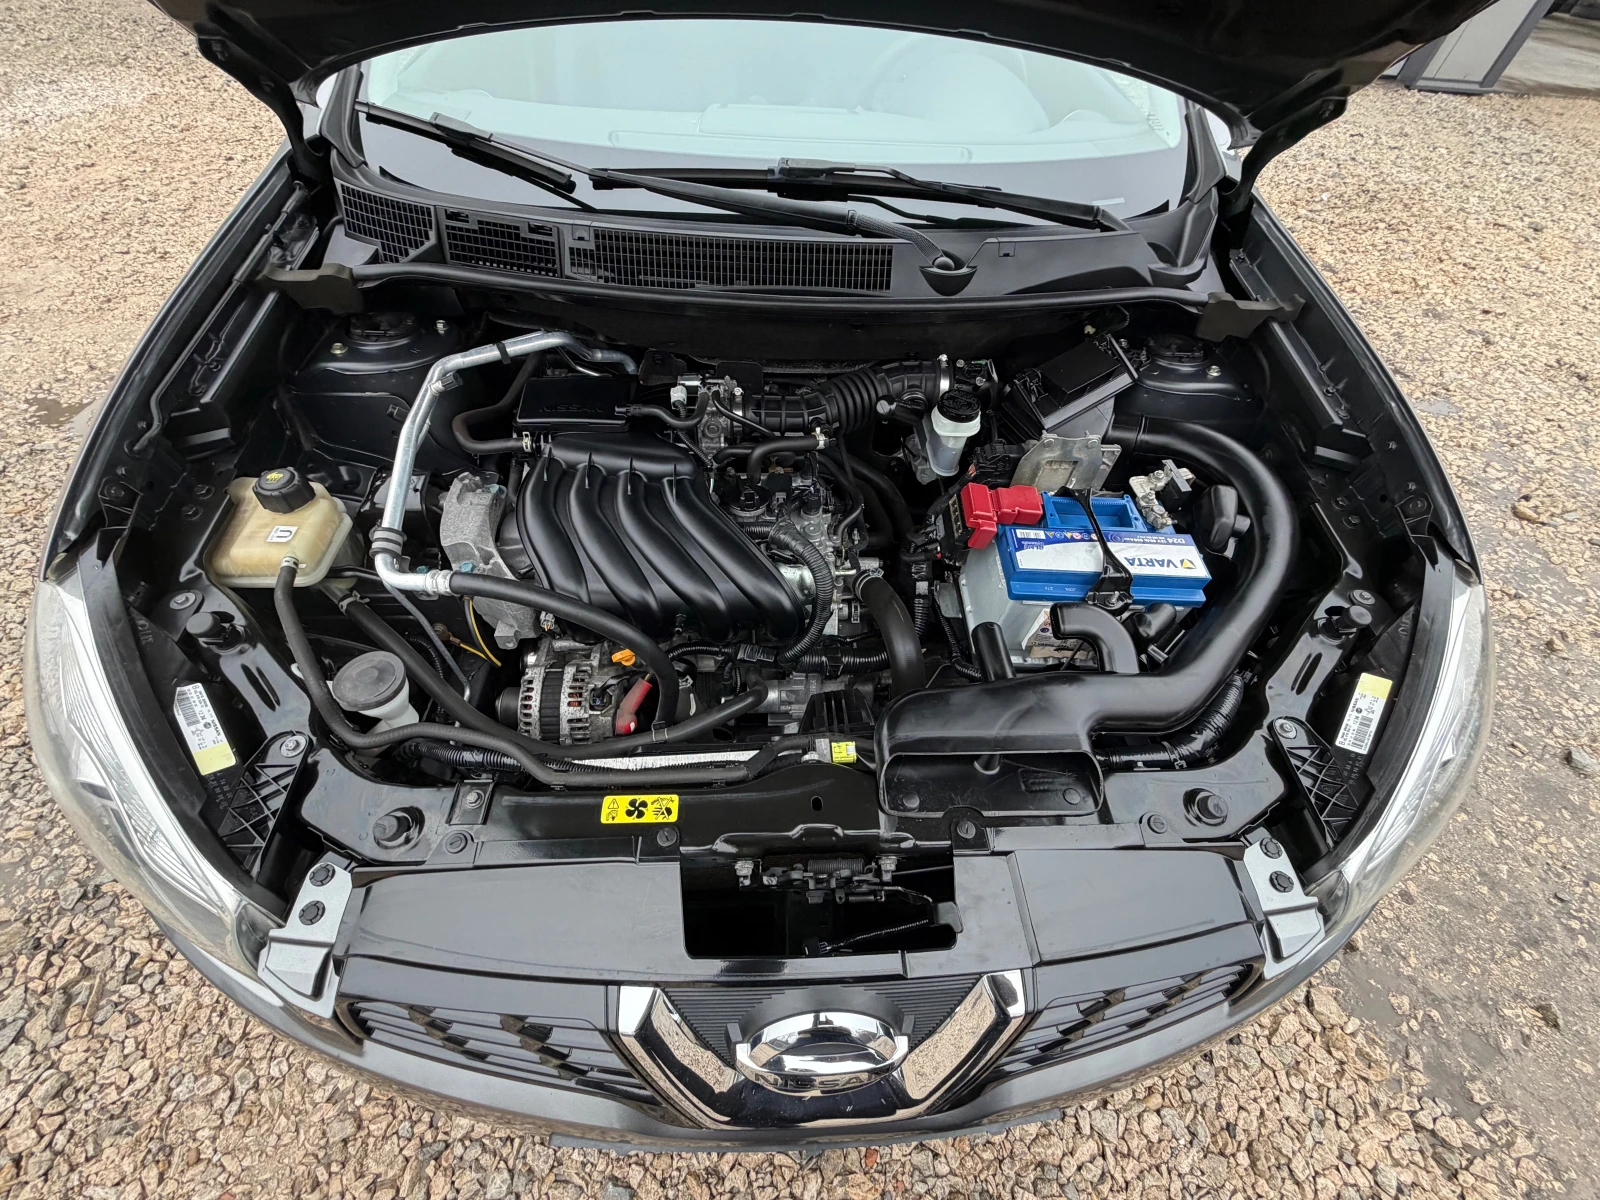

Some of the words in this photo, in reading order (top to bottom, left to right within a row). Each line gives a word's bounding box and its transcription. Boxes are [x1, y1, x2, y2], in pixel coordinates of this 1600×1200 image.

[276, 530, 292, 538] U
[1123, 556, 1179, 569] VARTA
[211, 719, 222, 737] NISSAN
[754, 1073, 883, 1089] NISSAN
